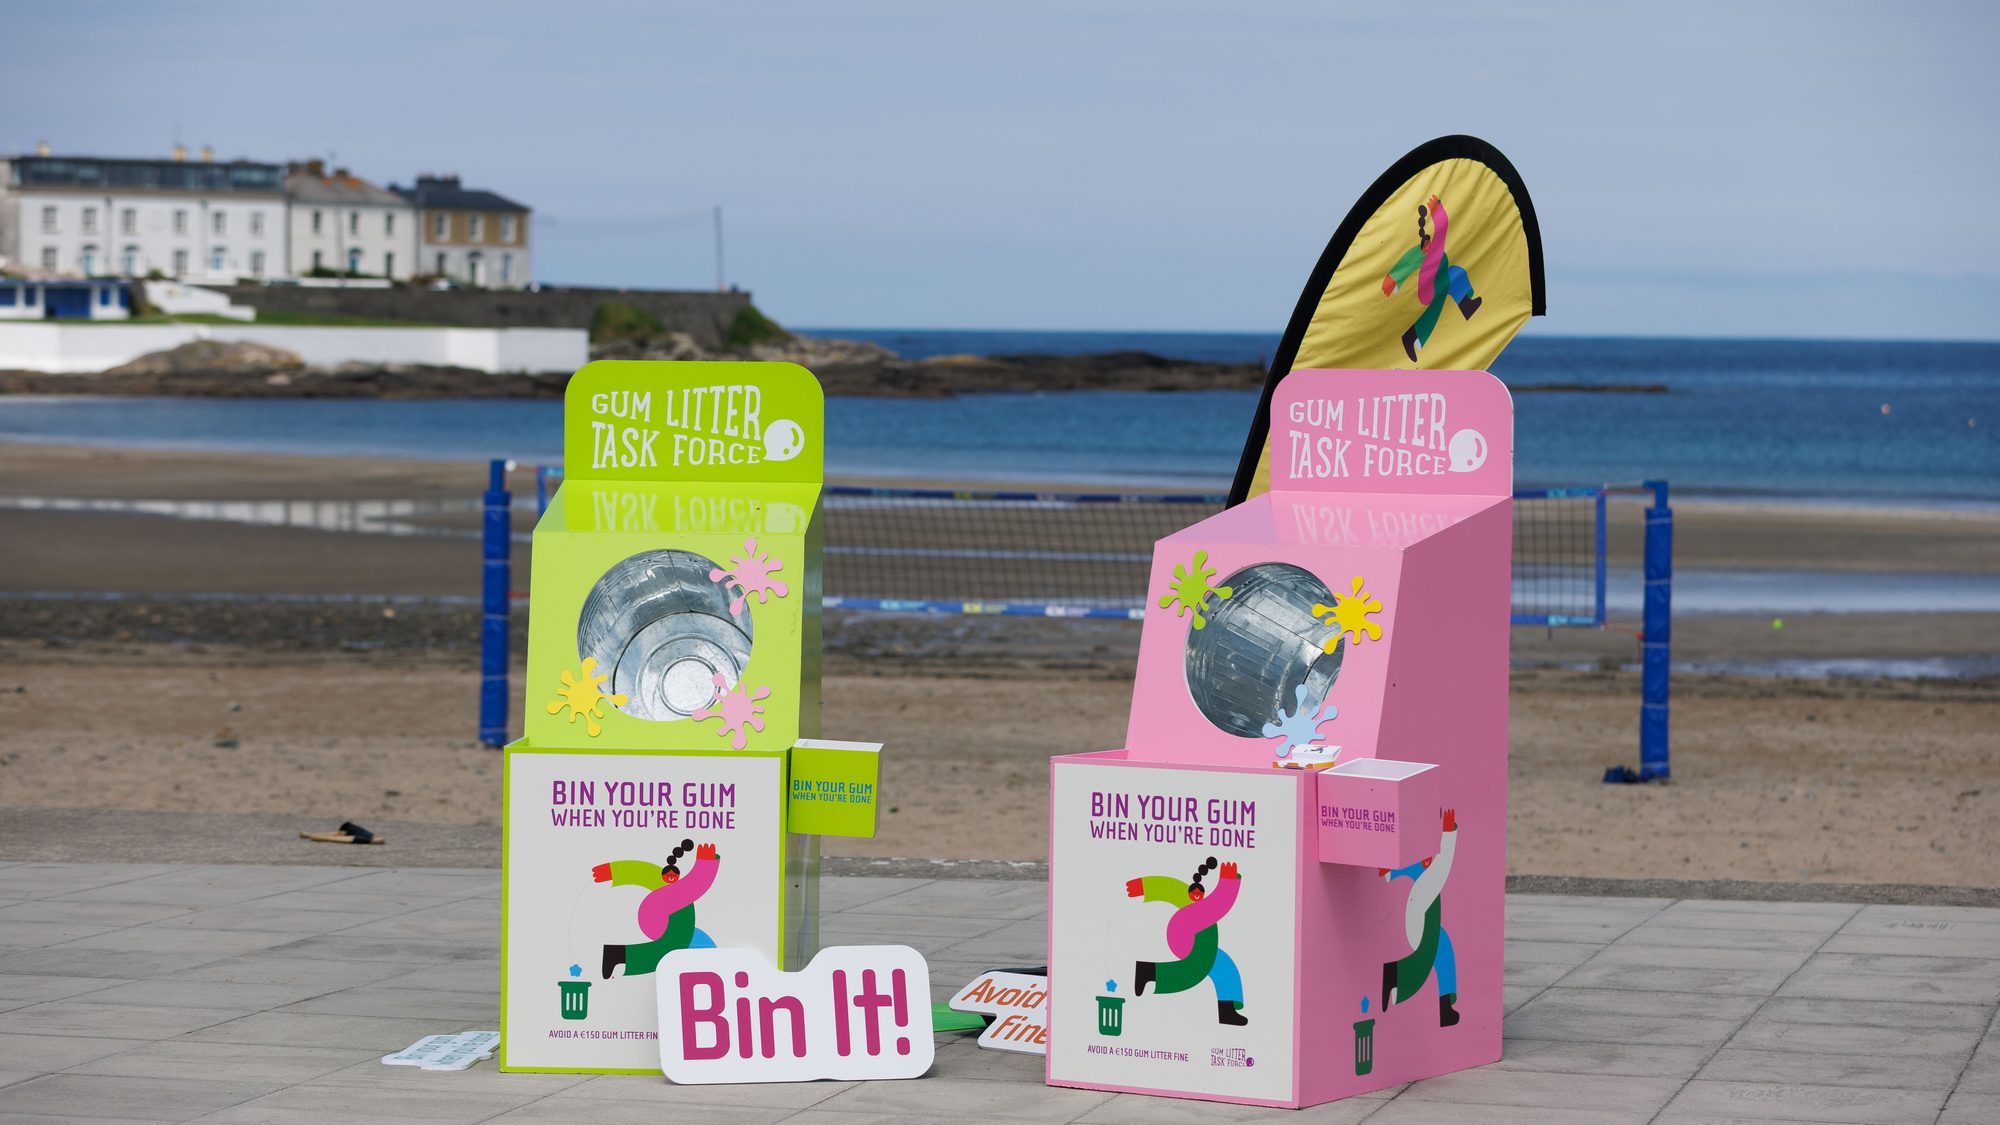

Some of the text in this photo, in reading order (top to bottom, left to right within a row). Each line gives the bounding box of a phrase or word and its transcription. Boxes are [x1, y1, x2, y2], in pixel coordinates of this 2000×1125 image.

[591, 384, 761, 441] GUM LITTER
[1289, 393, 1447, 450] GUM LITTER
[591, 421, 762, 469] TASK FORCE
[1289, 429, 1447, 479] TASK FORCE
[552, 780, 736, 808] BIN YOUR GUM
[792, 791, 816, 801] WHEN
[849, 794, 872, 804] DONE
[793, 779, 873, 795] BIN YOUR GUM
[551, 808, 736, 830] WHEN YOU'RE DONE
[1091, 791, 1256, 827] BIN YOUR GUM
[1321, 805, 1395, 823] BIN YOUR GUM
[1090, 820, 1256, 849] WHEN YOU'RE DONE
[1321, 818, 1344, 829] WHEN
[1374, 822, 1396, 833] DONE
[960, 978, 1047, 1009] Avoid
[679, 968, 911, 1060] Bin It!
[548, 1029, 572, 1039] AVOID
[573, 1030, 579, 1039] A
[580, 1030, 600, 1040] €150
[601, 1031, 618, 1040] GUM
[620, 1031, 644, 1040] LITTER
[1087, 1044, 1189, 1062] AVOID A €150 GUM LITTER FINE
[1210, 1054, 1225, 1066] TASK
[1225, 1048, 1246, 1062] LITTER
